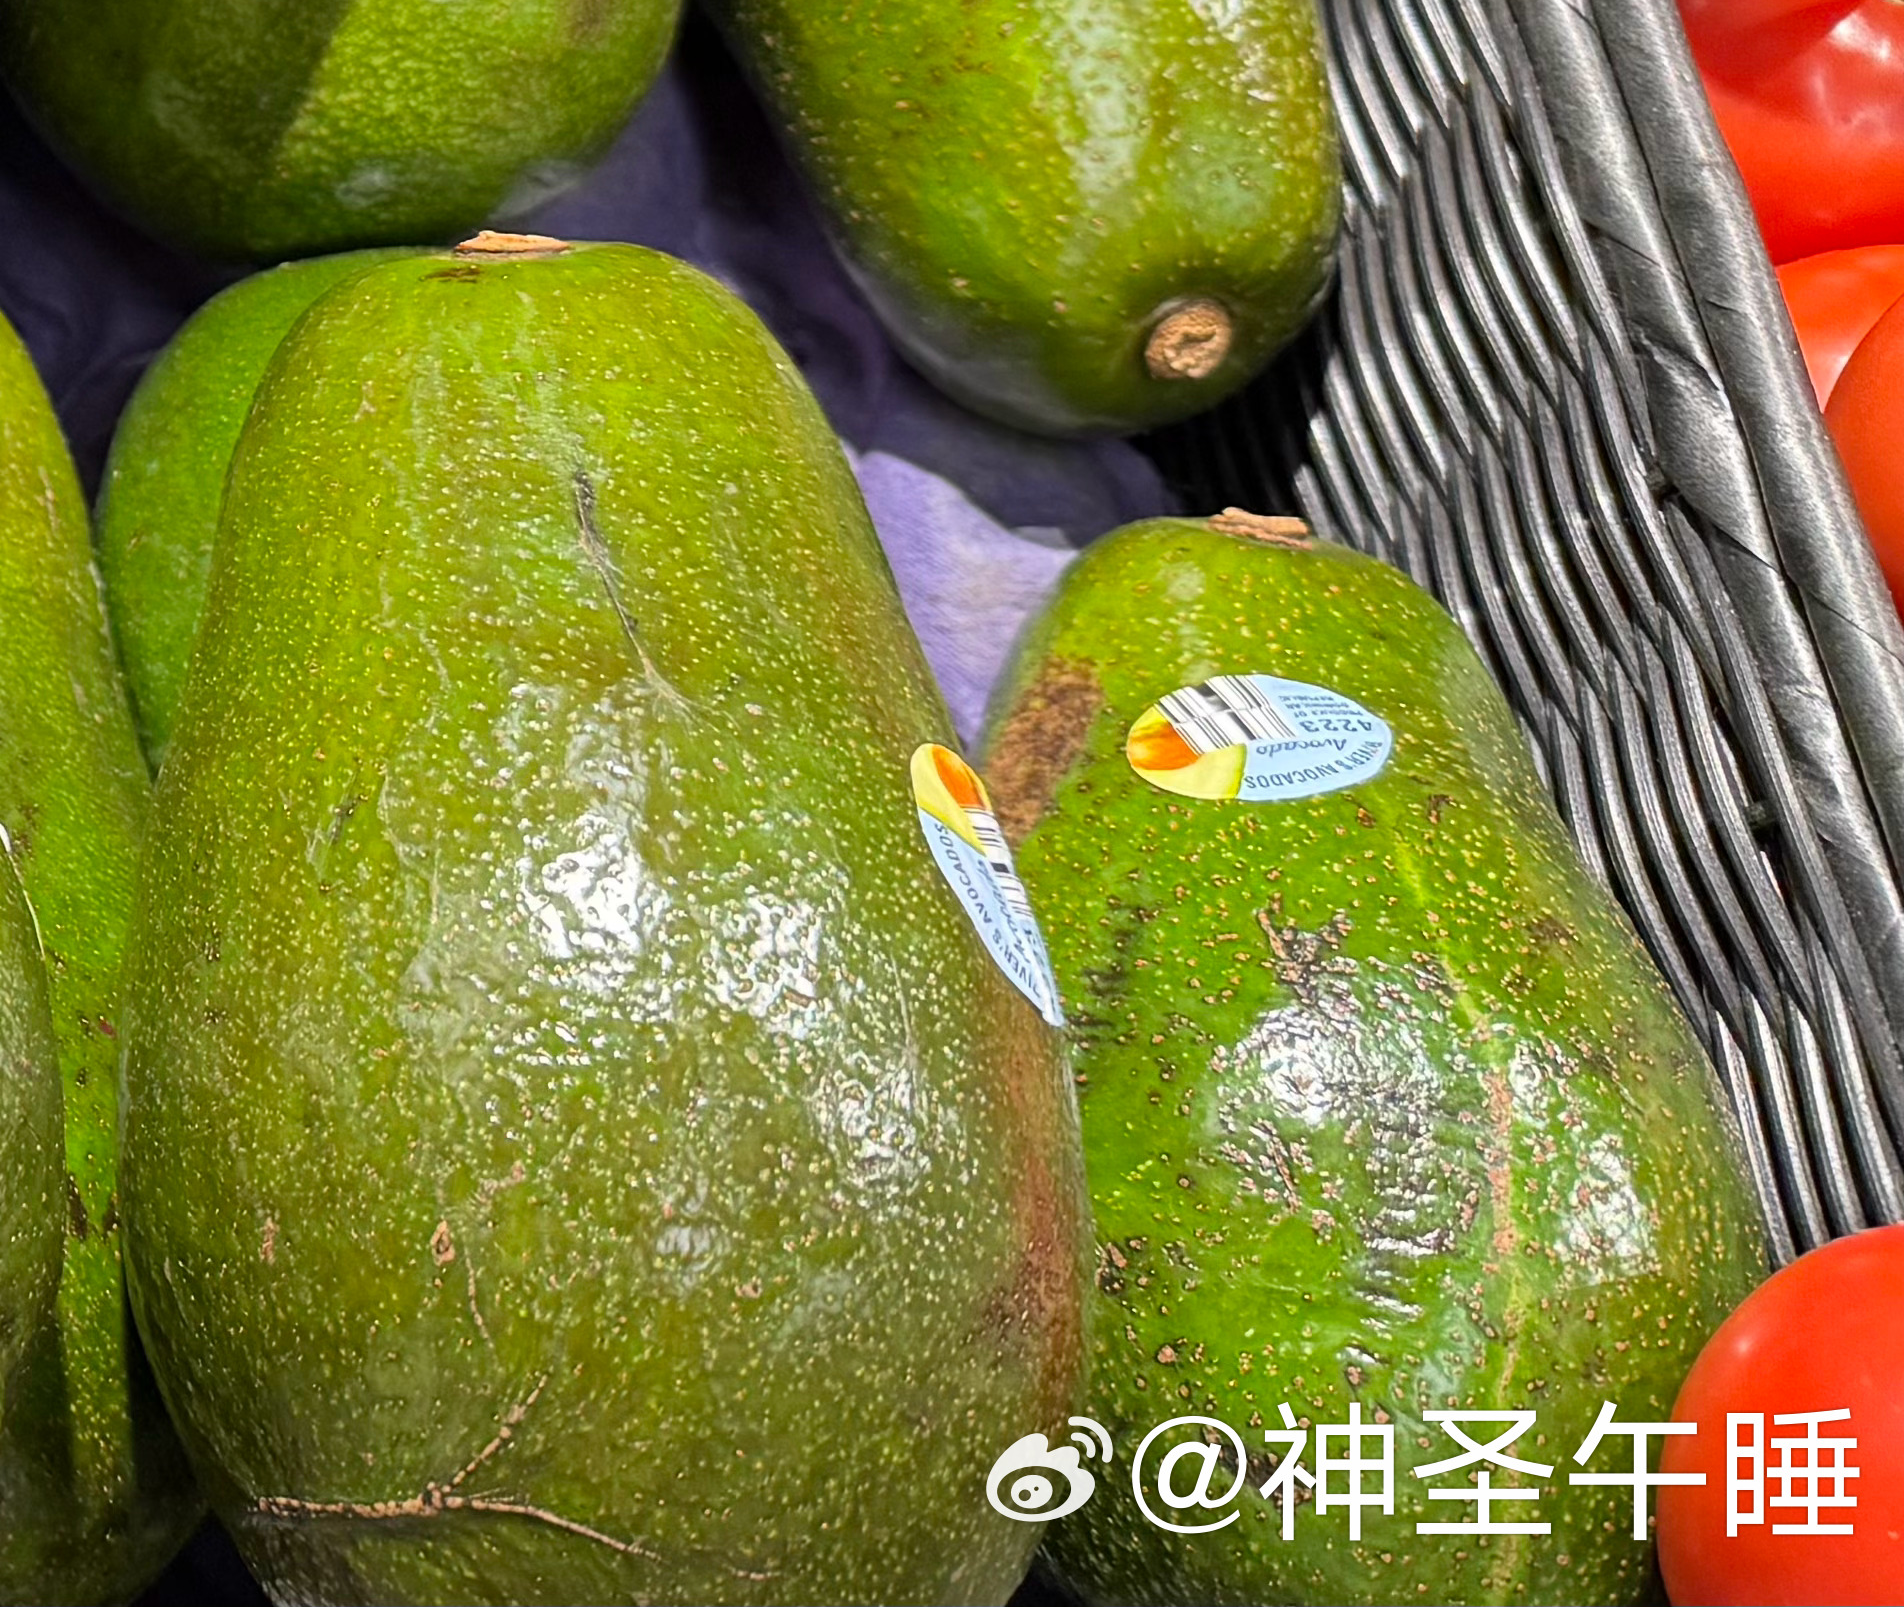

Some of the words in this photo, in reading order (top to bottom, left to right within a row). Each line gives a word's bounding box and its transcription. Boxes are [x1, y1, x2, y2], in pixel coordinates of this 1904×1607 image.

[1301, 718, 1373, 733] 4223
[1256, 737, 1348, 757] Avocado
[1343, 740, 1382, 772] RIVER'S
[1243, 762, 1339, 790] AVOCADOS
[934, 823, 992, 924] AVOCADOS
